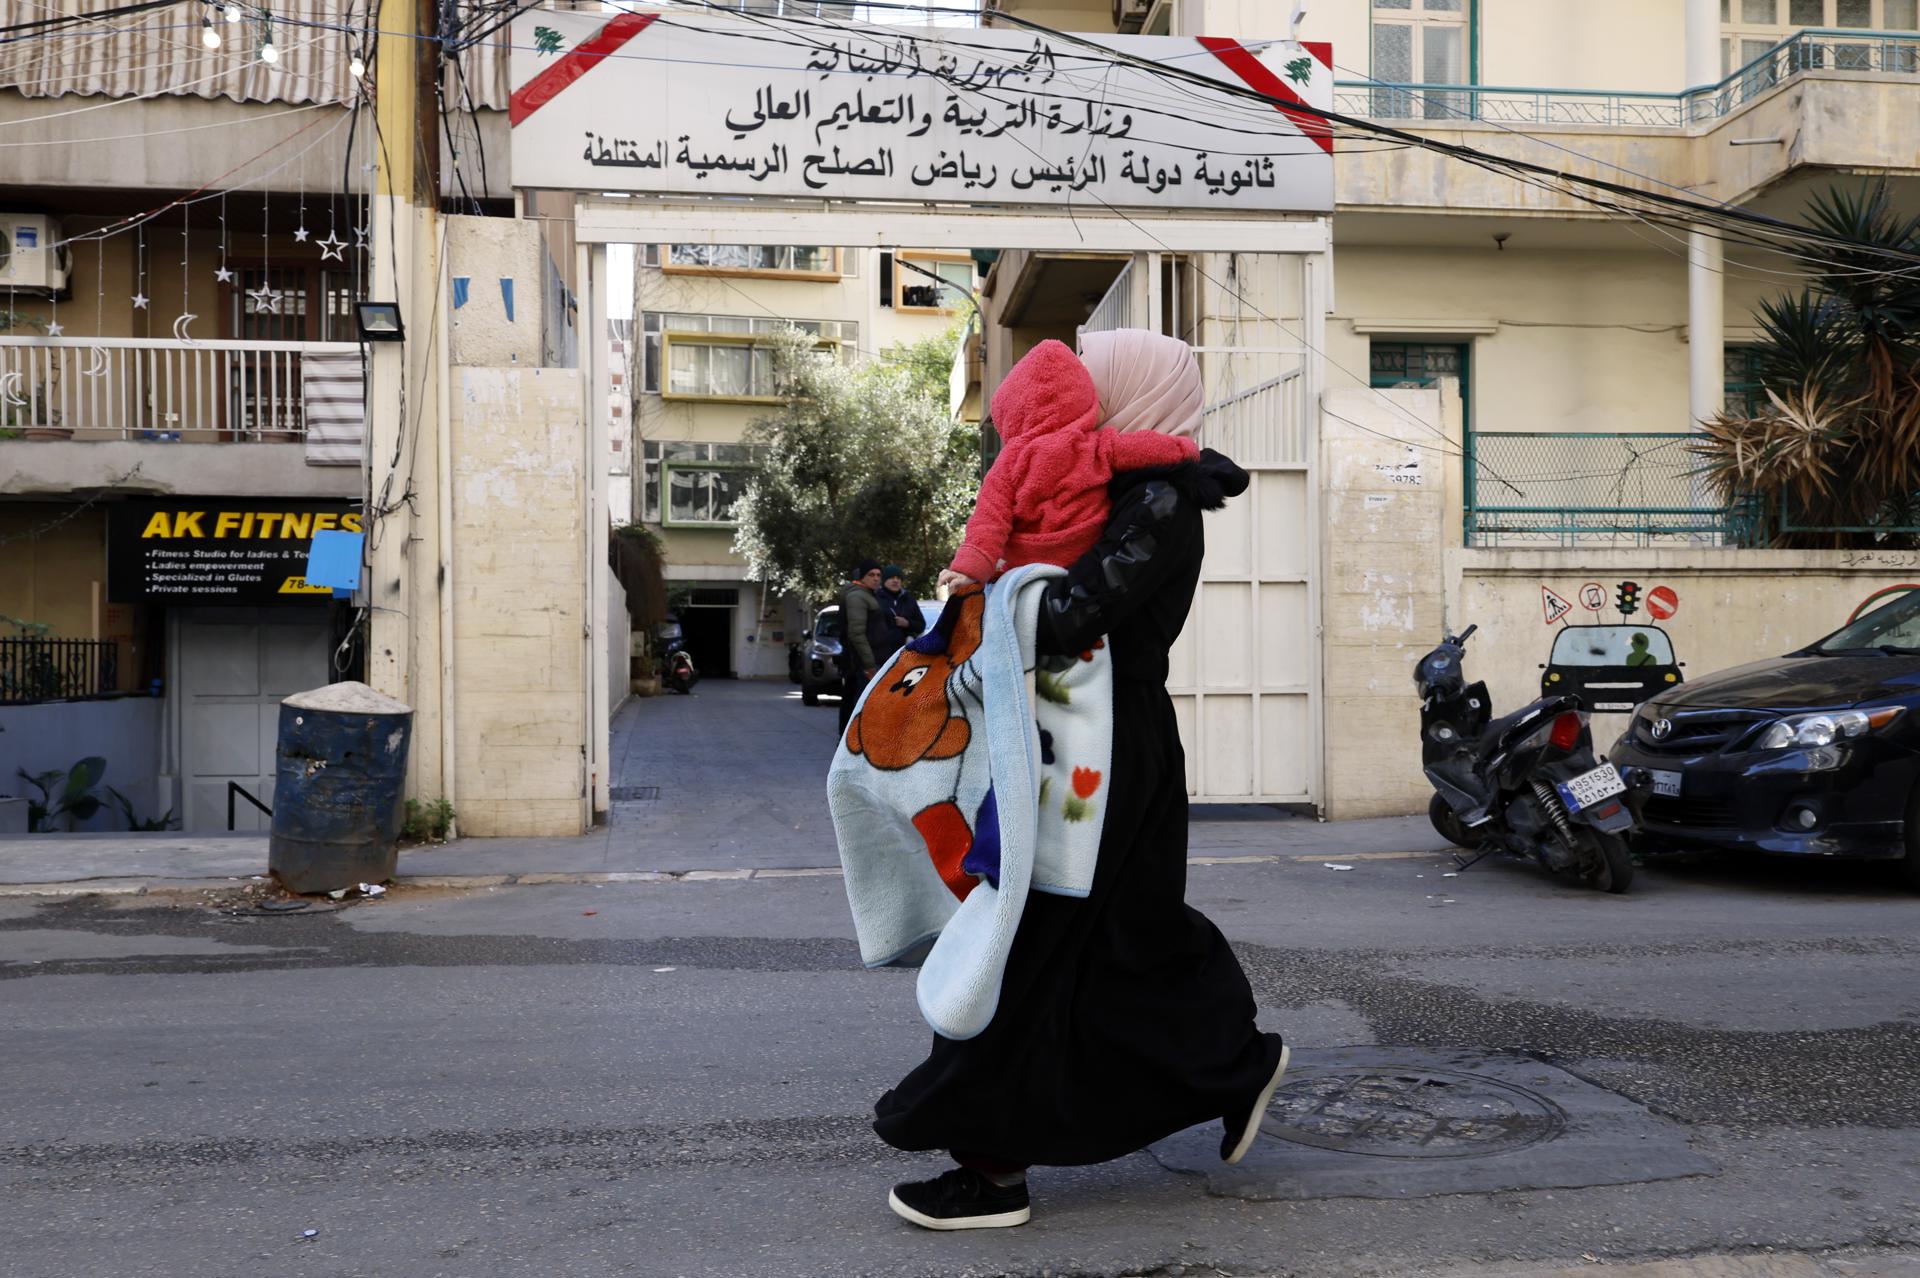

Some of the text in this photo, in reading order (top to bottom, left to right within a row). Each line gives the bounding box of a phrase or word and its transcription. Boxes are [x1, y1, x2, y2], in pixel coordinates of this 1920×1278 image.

[806, 37, 1055, 92] الجمهورية اللبنانية
[725, 84, 1133, 145] وزارة التربية والتعليم العالي
[583, 131, 1275, 196] ثانوية دولة الرئيس رياض الصلح الرسمية المختلطة
[141, 512, 206, 538] AK
[151, 550, 191, 558] Fitness
[193, 550, 227, 558] Studio
[230, 550, 245, 558] for
[247, 550, 278, 559] ladies
[282, 551, 290, 559] &
[151, 561, 265, 572] Ladies empowerment
[151, 585, 238, 593] Private sessions
[152, 573, 262, 582] Specialized in Glutes
[1575, 766, 1615, 790] 951530
